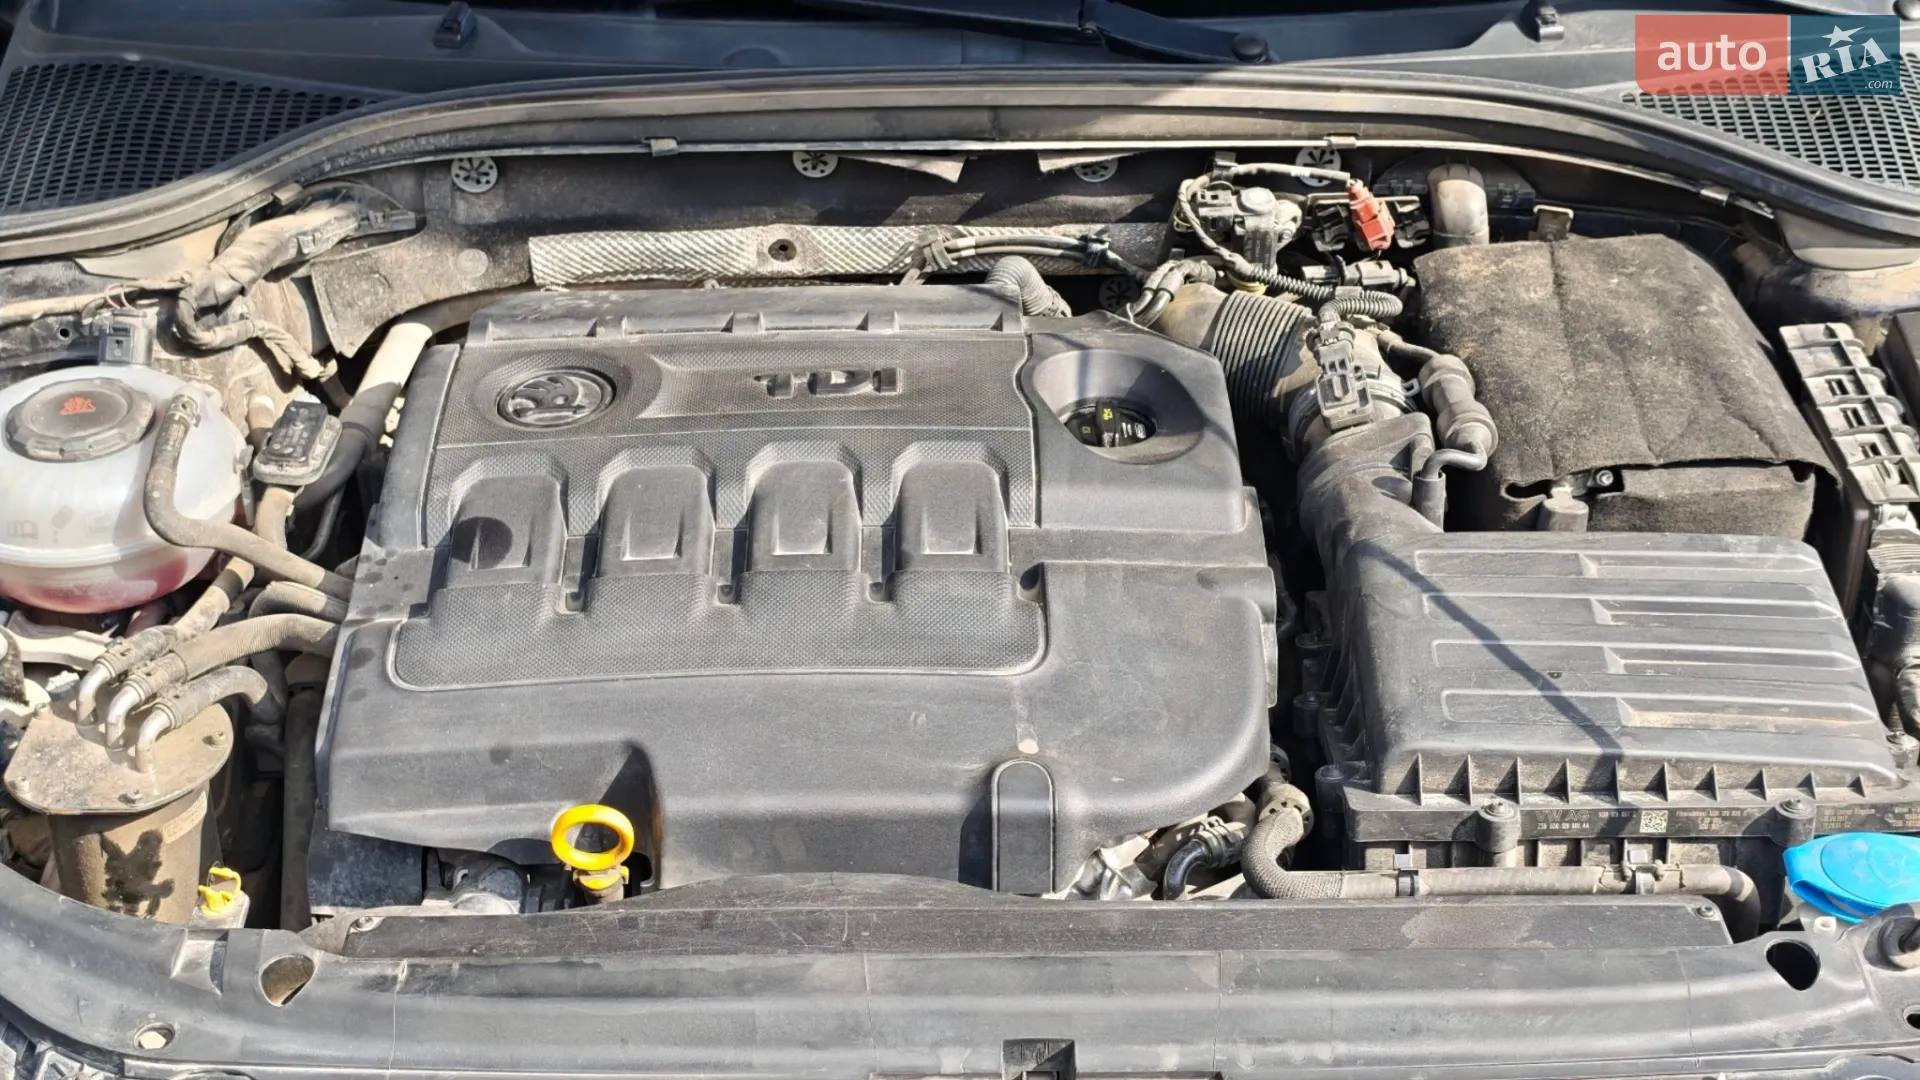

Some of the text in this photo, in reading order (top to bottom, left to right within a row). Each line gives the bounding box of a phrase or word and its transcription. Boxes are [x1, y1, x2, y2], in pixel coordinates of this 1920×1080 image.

[753, 367, 902, 399] TDI
[1535, 809, 1591, 822] VW AG
